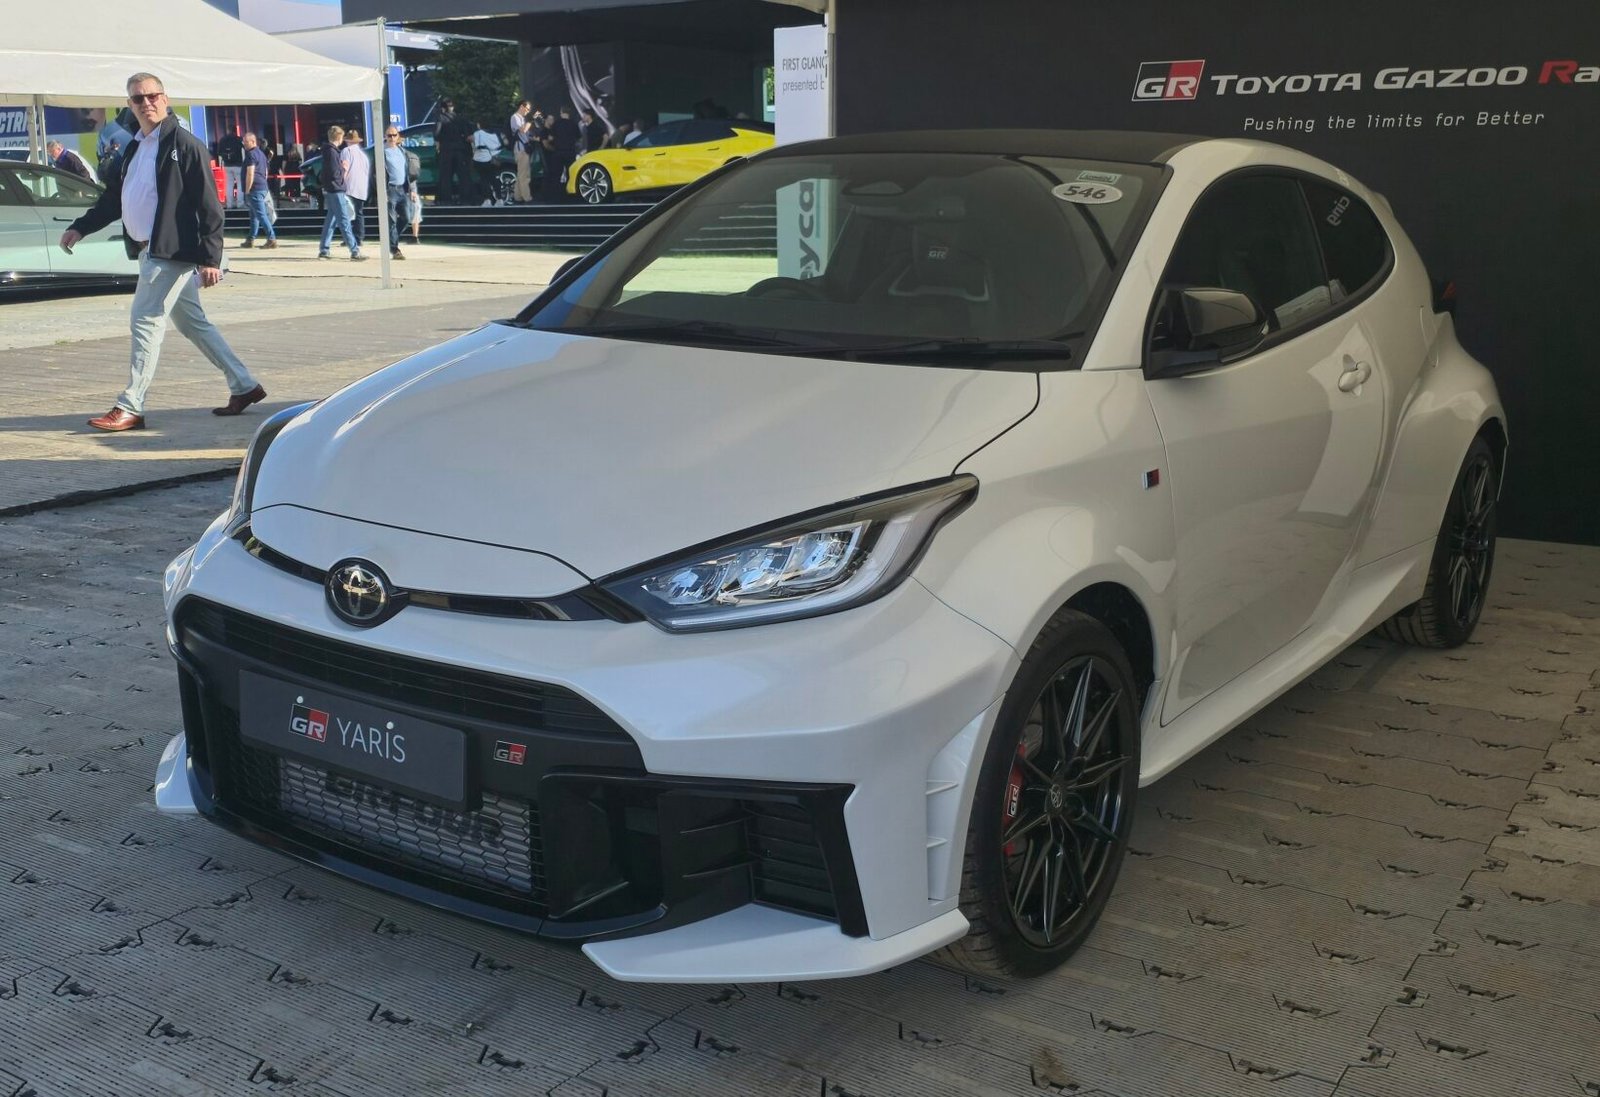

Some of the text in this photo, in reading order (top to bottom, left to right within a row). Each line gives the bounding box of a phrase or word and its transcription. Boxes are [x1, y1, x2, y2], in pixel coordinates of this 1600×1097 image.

[782, 57, 800, 71] FIRST
[782, 74, 818, 94] presented
[1134, 59, 1600, 100] GR TOYOTA GAZOO Ra
[0, 111, 40, 134] CTRI
[1243, 110, 1545, 133] Pushing the limits for Better
[1063, 185, 1107, 199] 546
[290, 713, 406, 763] GR YARIS
[495, 746, 525, 765] GR
[1009, 786, 1019, 817] GR
